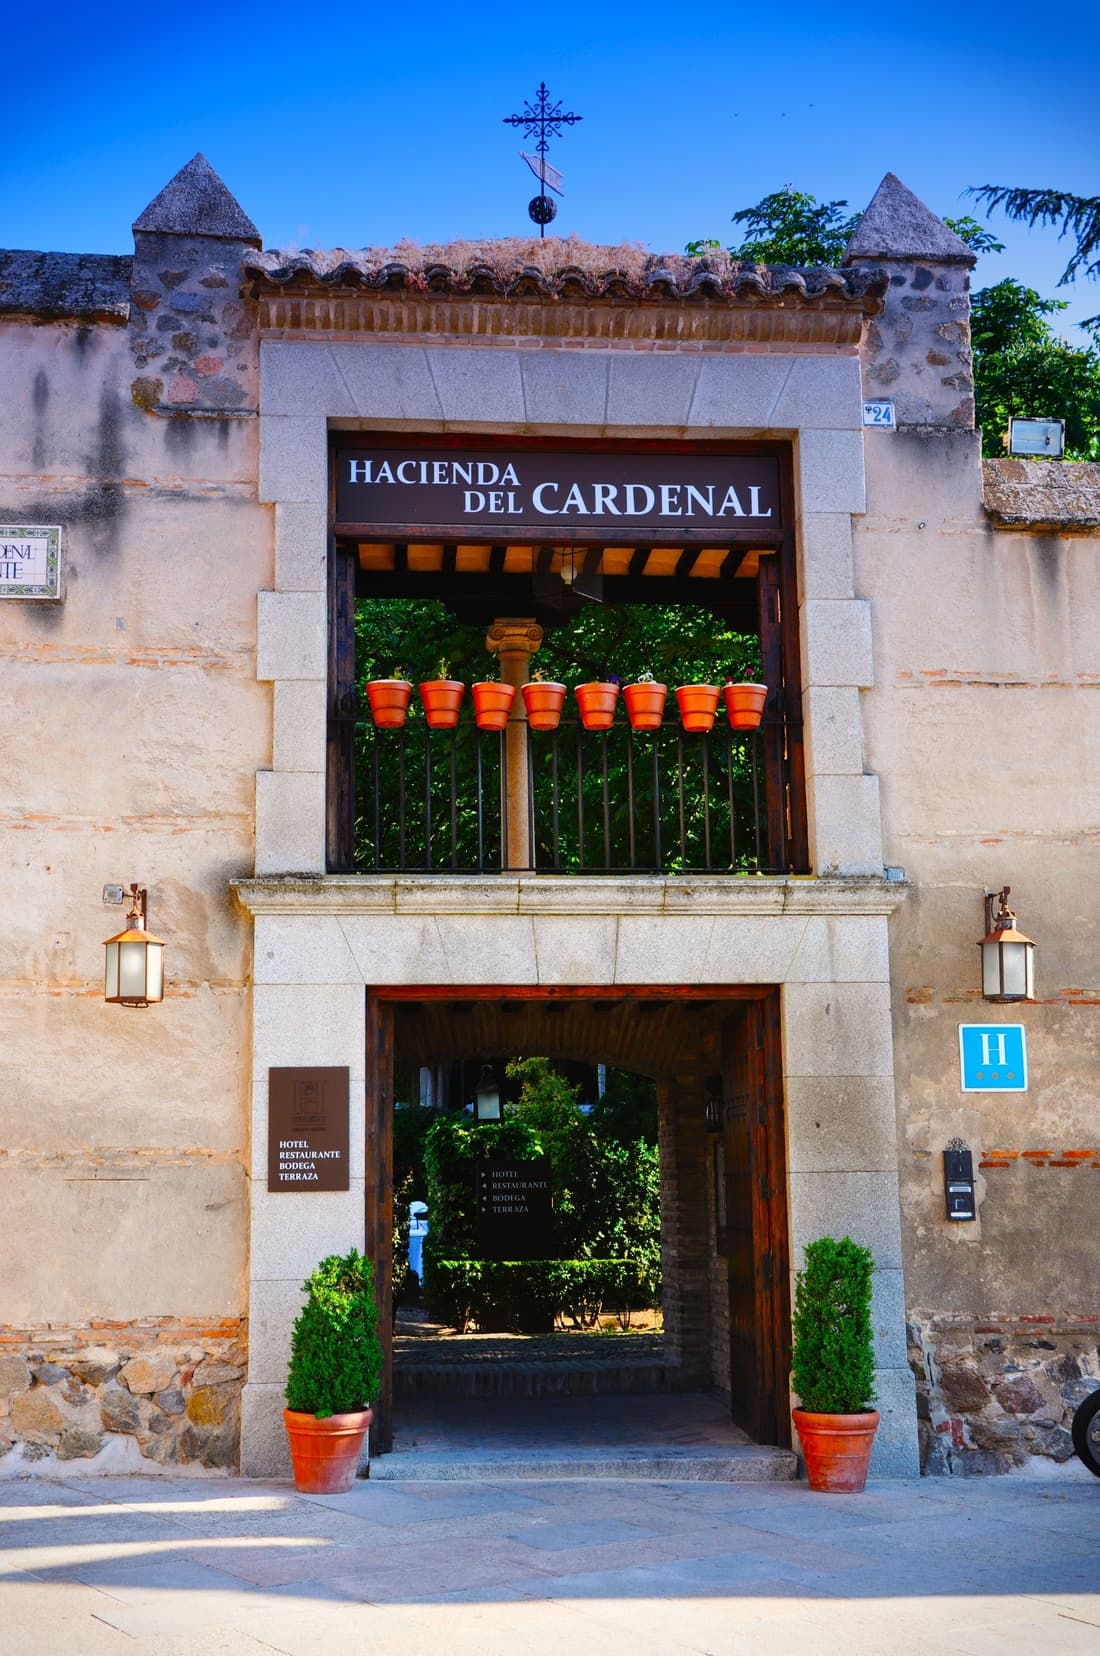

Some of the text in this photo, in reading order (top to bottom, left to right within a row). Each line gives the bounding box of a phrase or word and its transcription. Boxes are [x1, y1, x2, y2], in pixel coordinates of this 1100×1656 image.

[872, 406, 891, 422] 24
[348, 460, 521, 487] HACIENDA
[463, 482, 772, 517] DEL CARDENAL
[979, 1033, 1009, 1066] H
[279, 1140, 309, 1149] HOTEL
[279, 1150, 341, 1160] RESTAURANTE
[279, 1161, 316, 1170] BODEGA
[279, 1172, 319, 1181] TERRAZA
[492, 1170, 519, 1178] HOTEL
[492, 1181, 547, 1190] RESTAURANTE
[492, 1194, 526, 1202] BODEGA
[492, 1205, 529, 1213] TERRAZA
